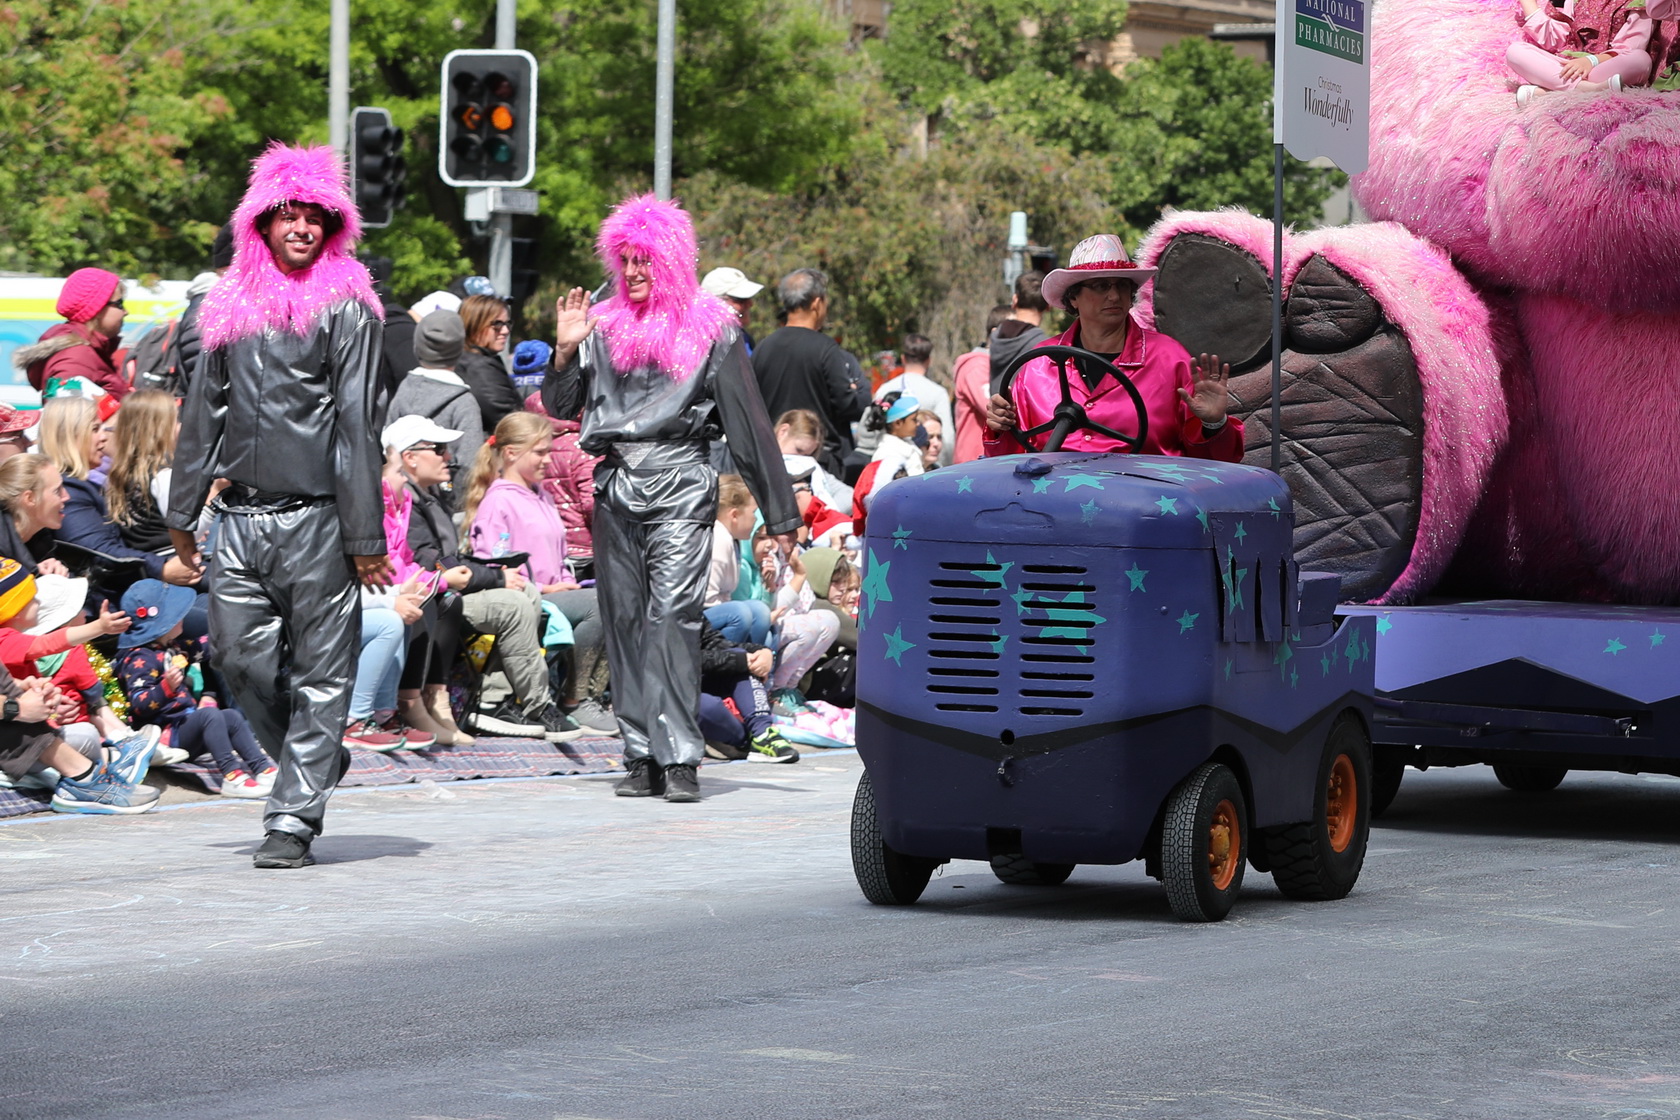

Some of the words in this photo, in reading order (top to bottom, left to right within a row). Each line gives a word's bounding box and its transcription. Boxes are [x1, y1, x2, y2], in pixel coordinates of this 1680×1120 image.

[1298, 22, 1361, 56] PHARMACIES
[1317, 76, 1343, 93] Christmas
[1303, 86, 1355, 130] Wonderfully
